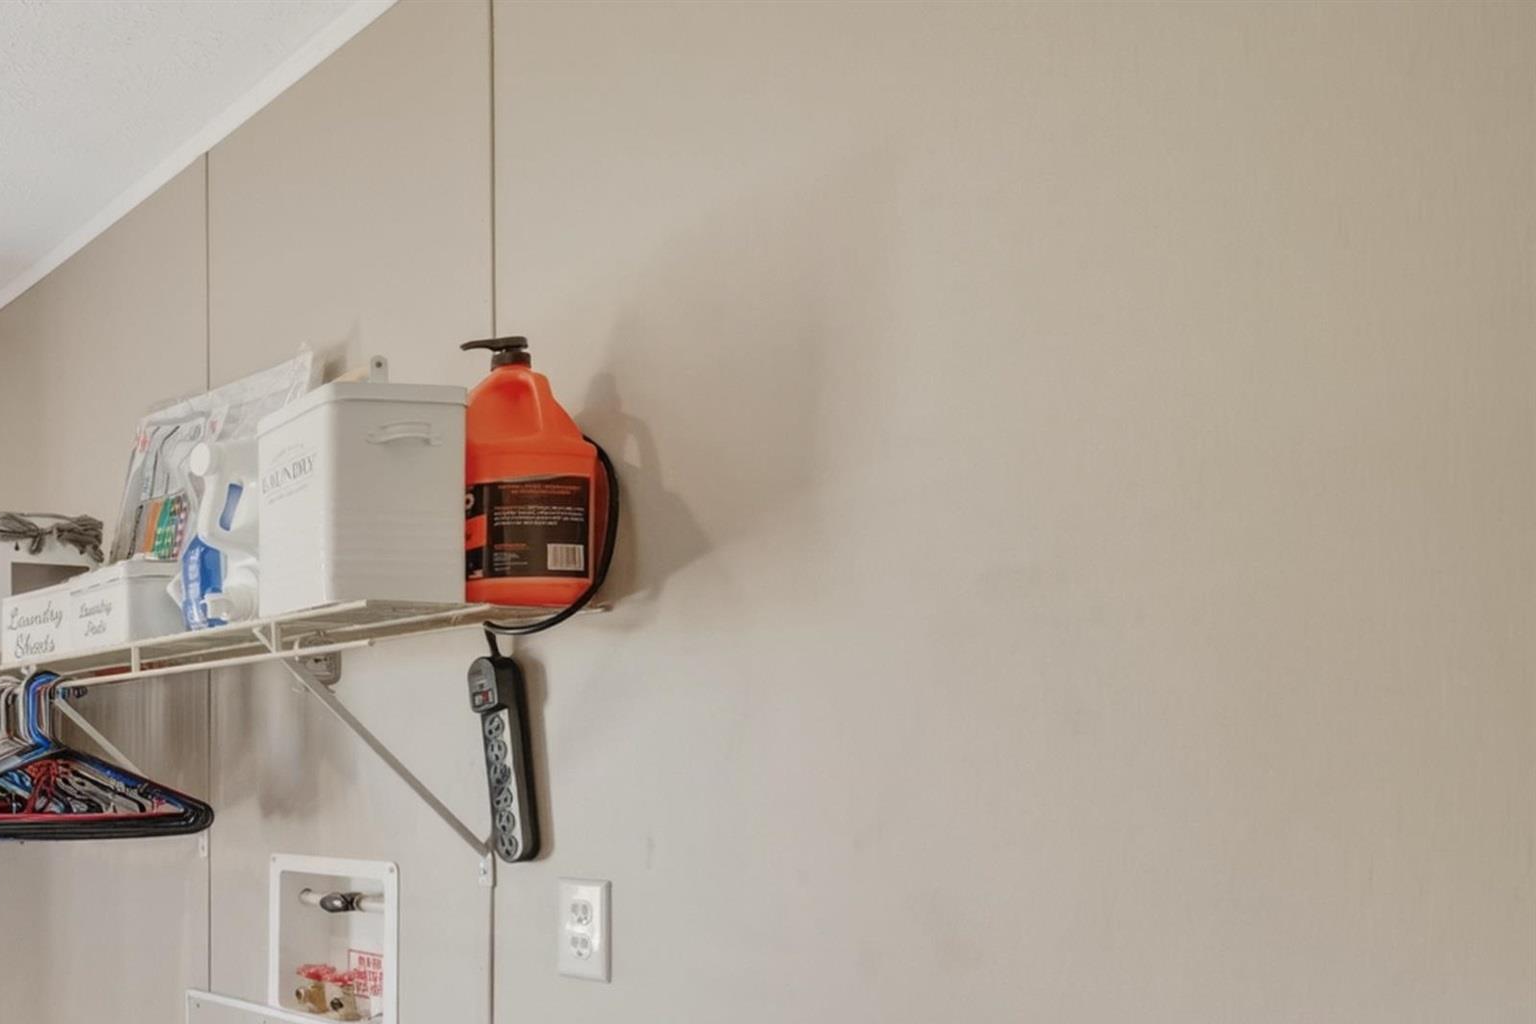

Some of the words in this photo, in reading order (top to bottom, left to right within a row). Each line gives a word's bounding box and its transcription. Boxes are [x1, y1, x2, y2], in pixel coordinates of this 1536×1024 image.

[8, 601, 64, 631] Laundry
[78, 599, 113, 620] Laundry
[15, 632, 56, 660] Sheets
